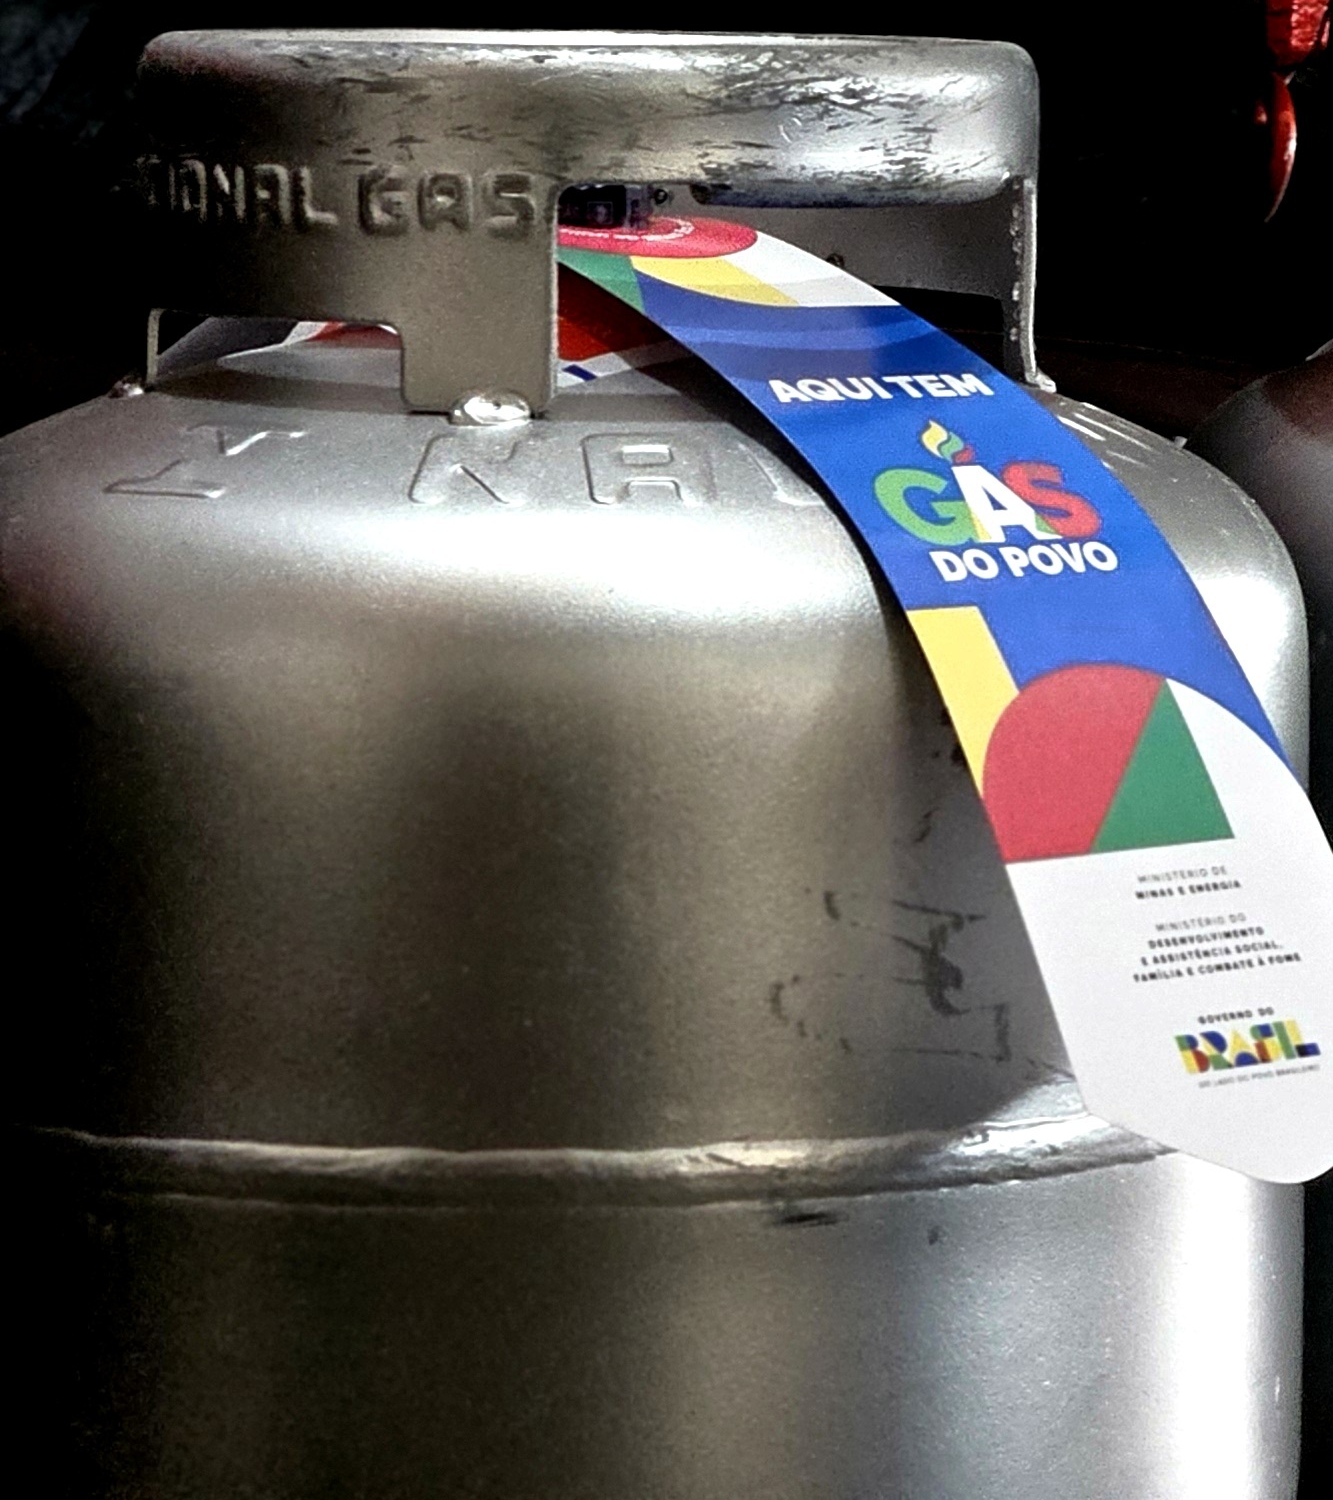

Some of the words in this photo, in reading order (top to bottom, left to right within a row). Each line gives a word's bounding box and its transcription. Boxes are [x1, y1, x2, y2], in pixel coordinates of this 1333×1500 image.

[358, 167, 537, 236] GAS
[768, 377, 893, 402] AQUI
[883, 373, 994, 398] TEM
[929, 548, 999, 581] DO
[999, 541, 1118, 577] POVO
[1135, 887, 1174, 900] MINAS
[1178, 886, 1186, 896] E
[1188, 880, 1242, 894] ENERGIA
[1148, 926, 1265, 950] DESENVOLVIMENTO
[1141, 956, 1149, 966] E
[1186, 967, 1194, 976] E
[1198, 958, 1255, 975] COMBATE
[1267, 952, 1302, 965] FOME
[1198, 1008, 1253, 1025] GOVERNO
[1257, 1006, 1275, 1017] DO
[1174, 1018, 1321, 1075] BRASIL
